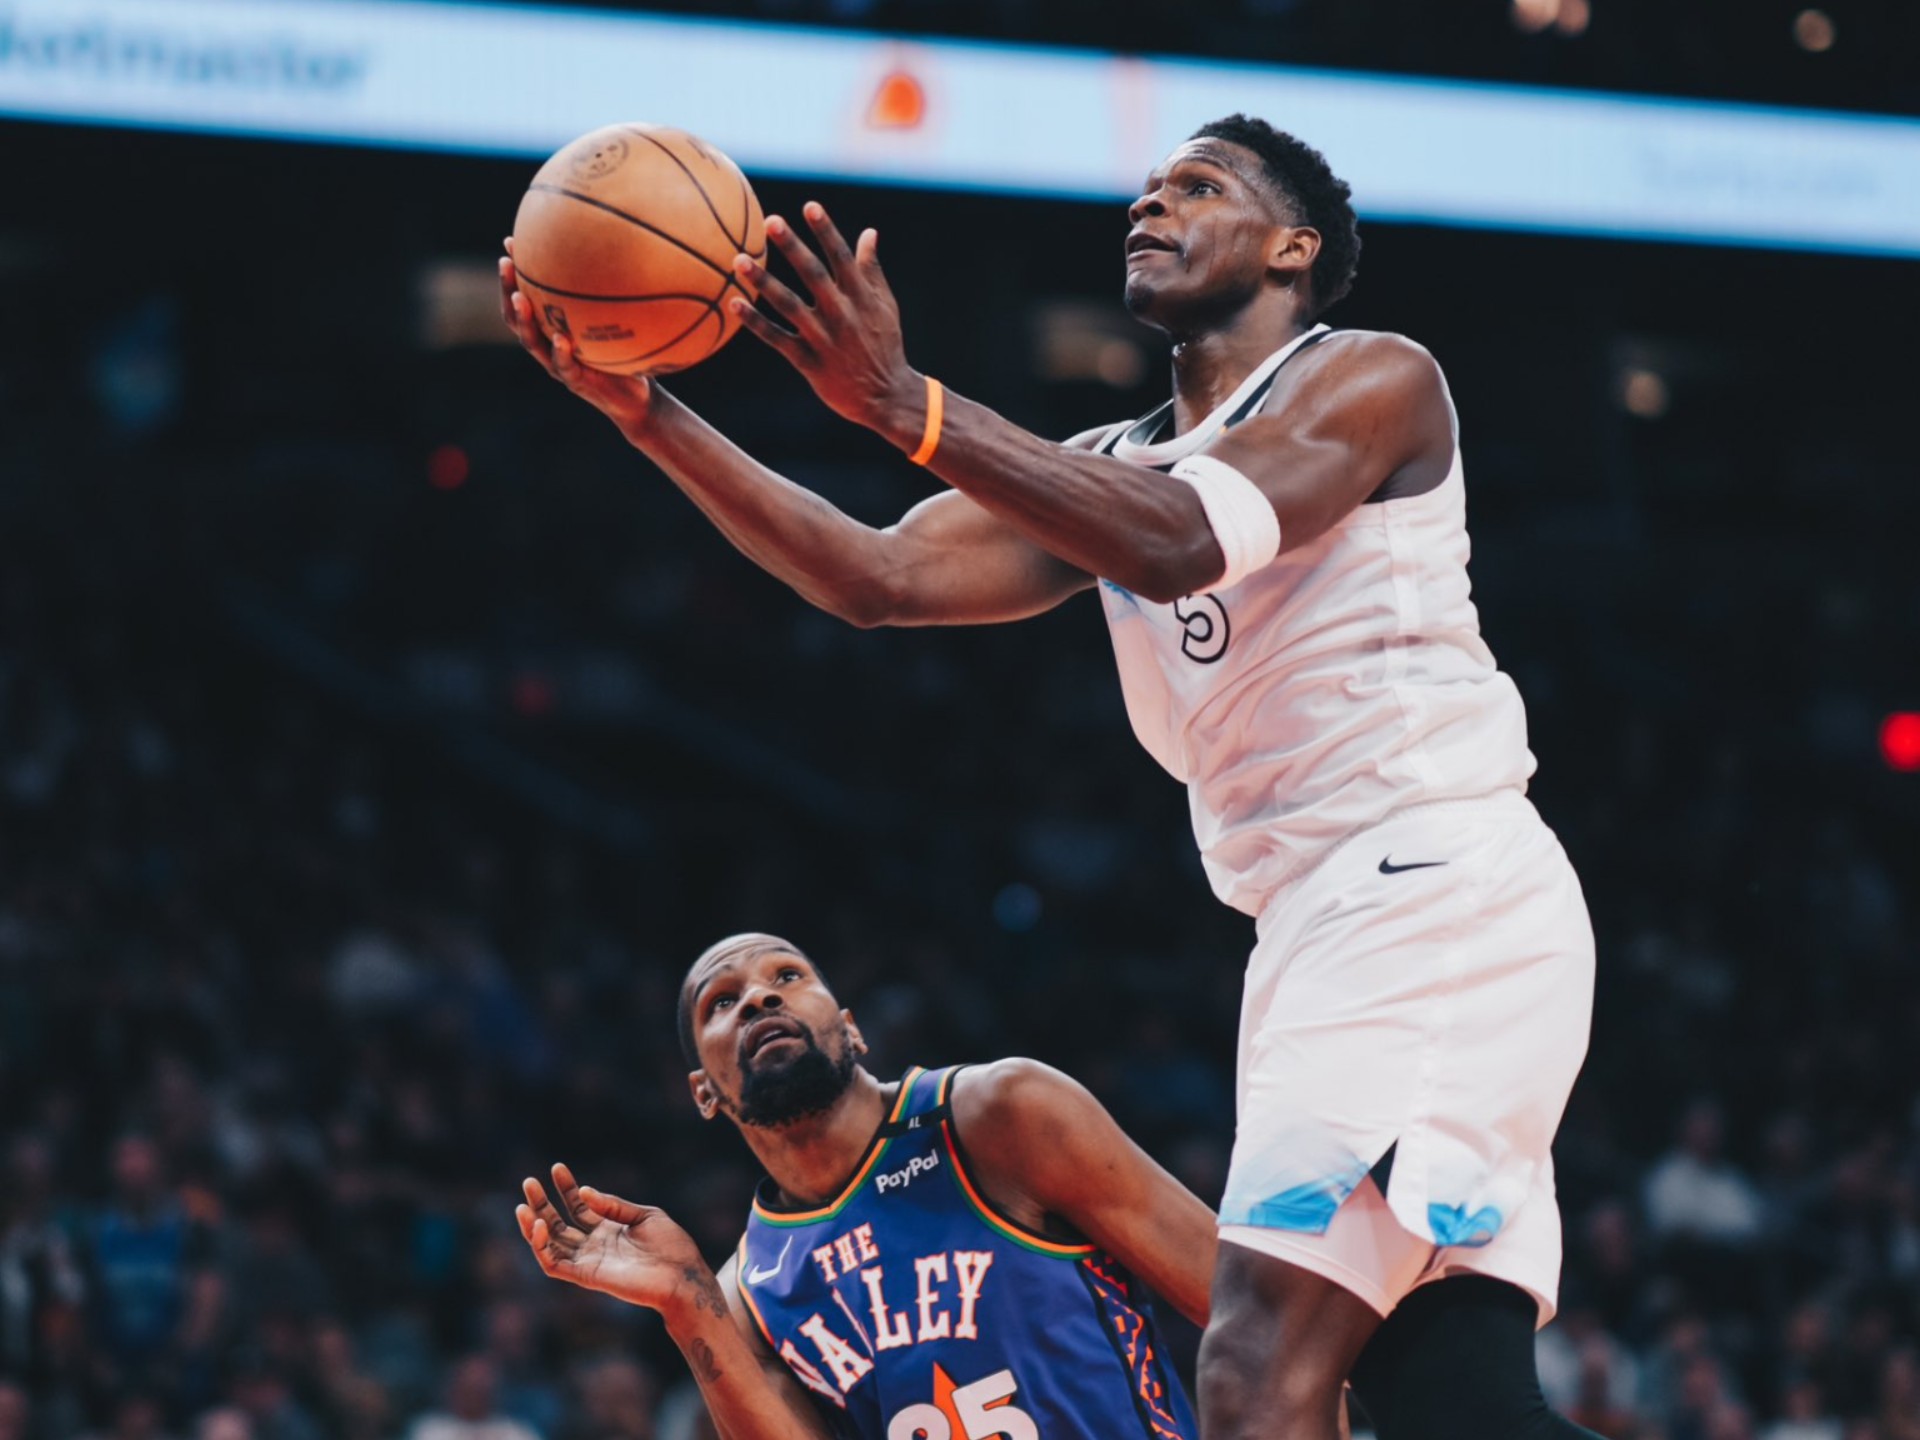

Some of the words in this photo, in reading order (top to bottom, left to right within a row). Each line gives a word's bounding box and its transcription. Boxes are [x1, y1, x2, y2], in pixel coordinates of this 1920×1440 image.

[908, 1116, 921, 1129] AL
[875, 1149, 939, 1194] PayPal
[812, 1222, 880, 1283] THE
[779, 1250, 994, 1409] VALEY
